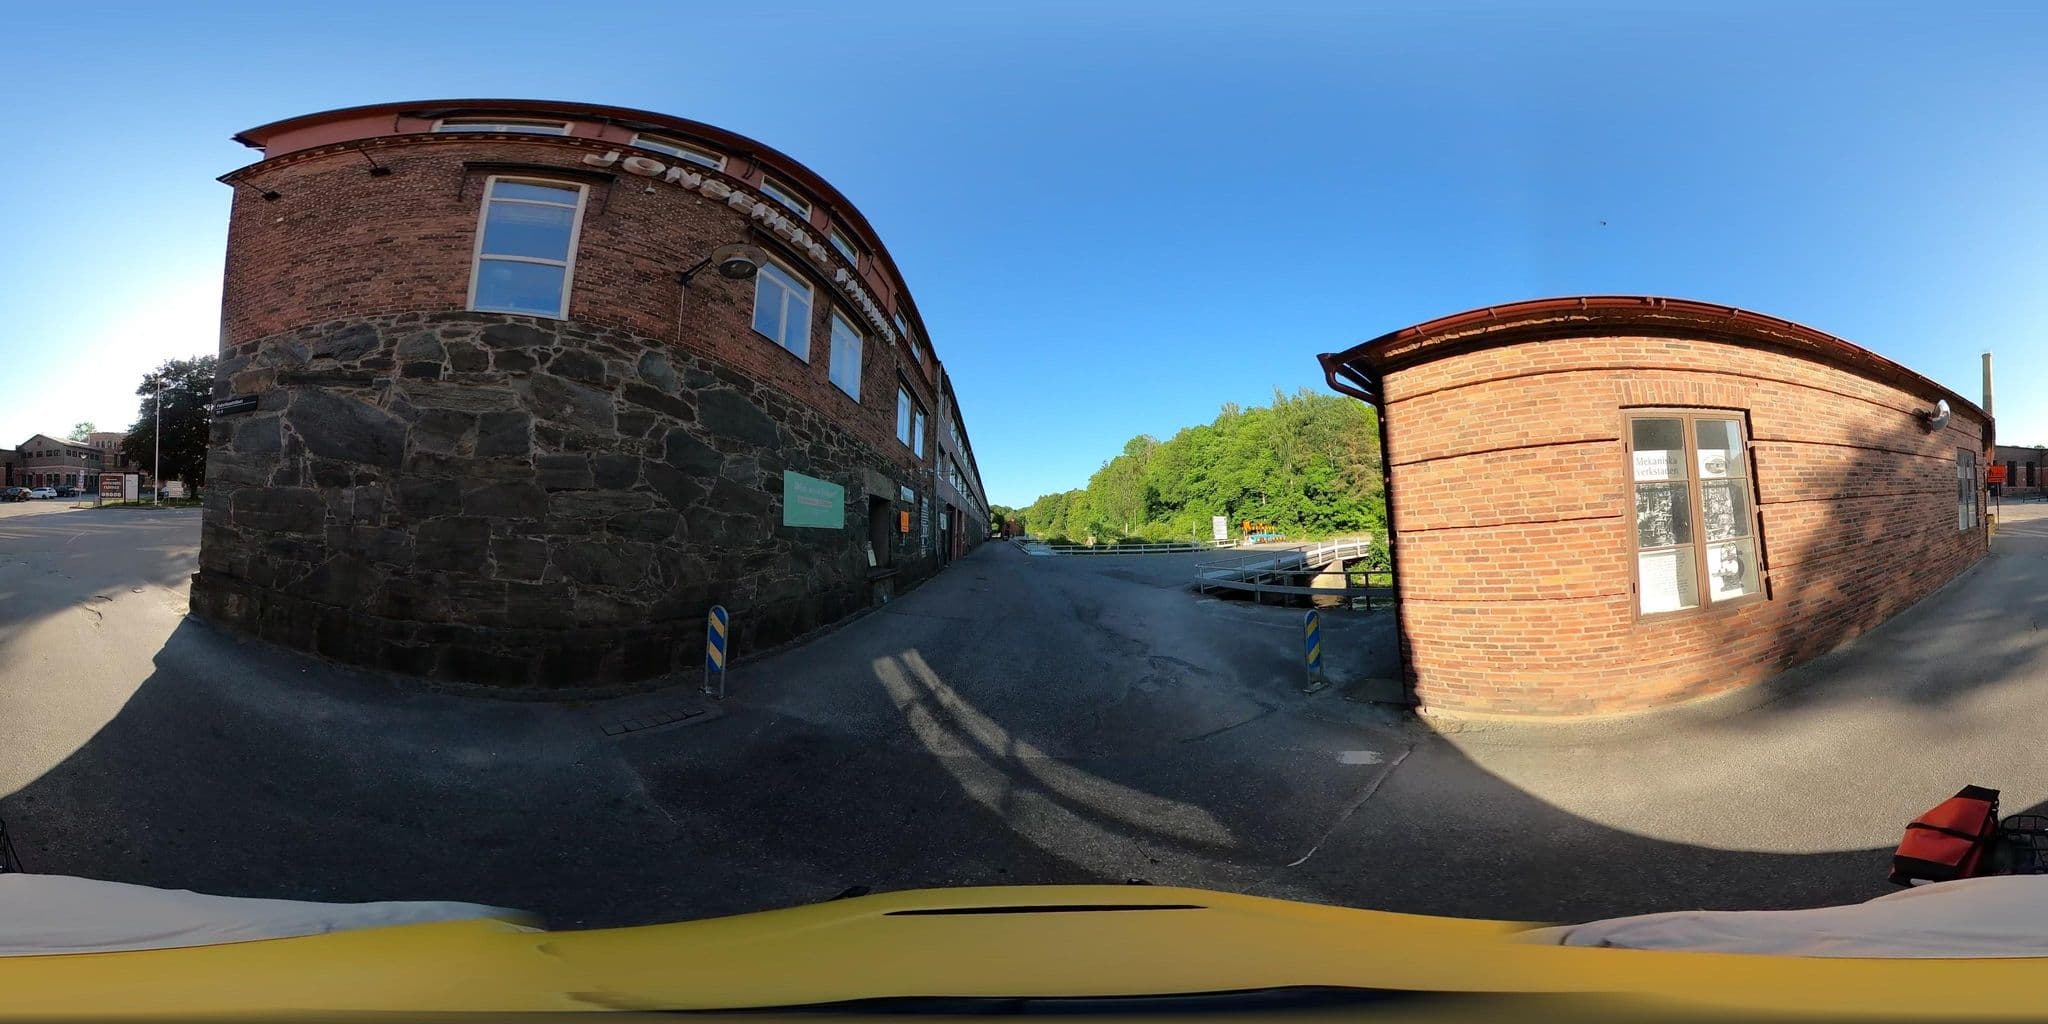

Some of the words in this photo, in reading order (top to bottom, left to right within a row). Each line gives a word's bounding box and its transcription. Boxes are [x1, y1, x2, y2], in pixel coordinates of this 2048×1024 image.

[582, 151, 828, 263] JONSEREDS
[1636, 455, 1679, 466] Mekaniska
[1637, 466, 1680, 476] verkstaden
